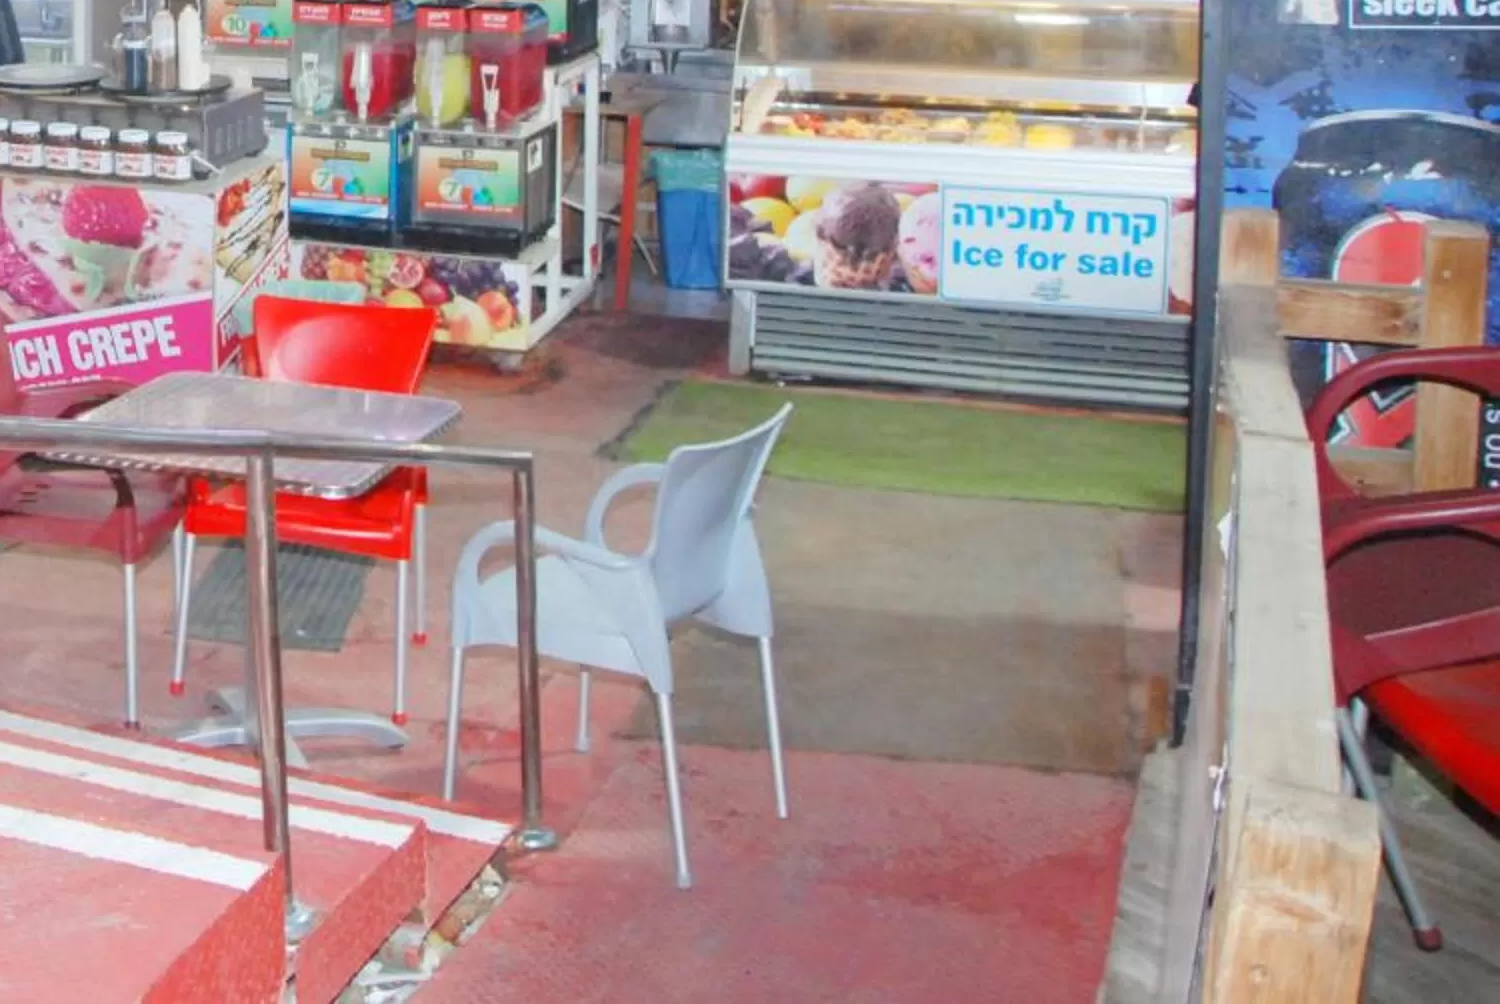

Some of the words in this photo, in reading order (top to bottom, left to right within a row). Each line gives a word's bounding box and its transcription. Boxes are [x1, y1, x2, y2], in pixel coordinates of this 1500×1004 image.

[952, 199, 1075, 234] למכירה
[1084, 207, 1157, 245] קרח
[952, 240, 1004, 268] Ice
[1016, 243, 1066, 272] for
[1077, 250, 1154, 278] sale
[67, 316, 181, 371] CREPE
